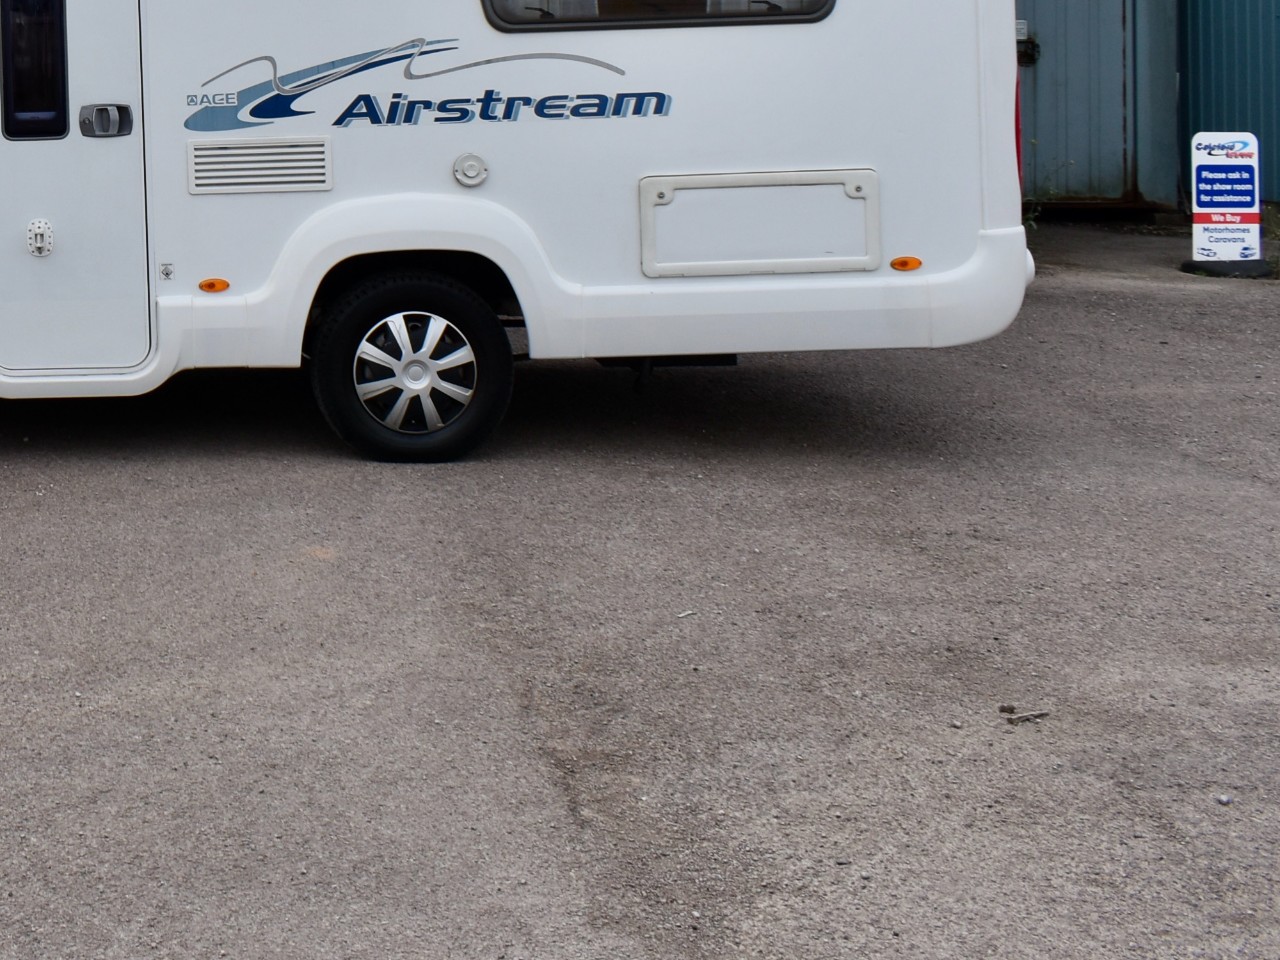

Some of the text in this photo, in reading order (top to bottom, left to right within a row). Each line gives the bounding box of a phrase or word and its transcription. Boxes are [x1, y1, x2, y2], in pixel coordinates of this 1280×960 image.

[199, 92, 236, 106] ACE
[332, 90, 672, 128] Airstream
[1201, 171, 1250, 179] Please ask in
[1213, 183, 1232, 191] show
[1233, 183, 1253, 191] room
[1200, 194, 1252, 202] for assistance
[1211, 213, 1241, 223] We Buy
[1202, 226, 1251, 234] Motorhomes
[1207, 235, 1246, 243] Caravans
